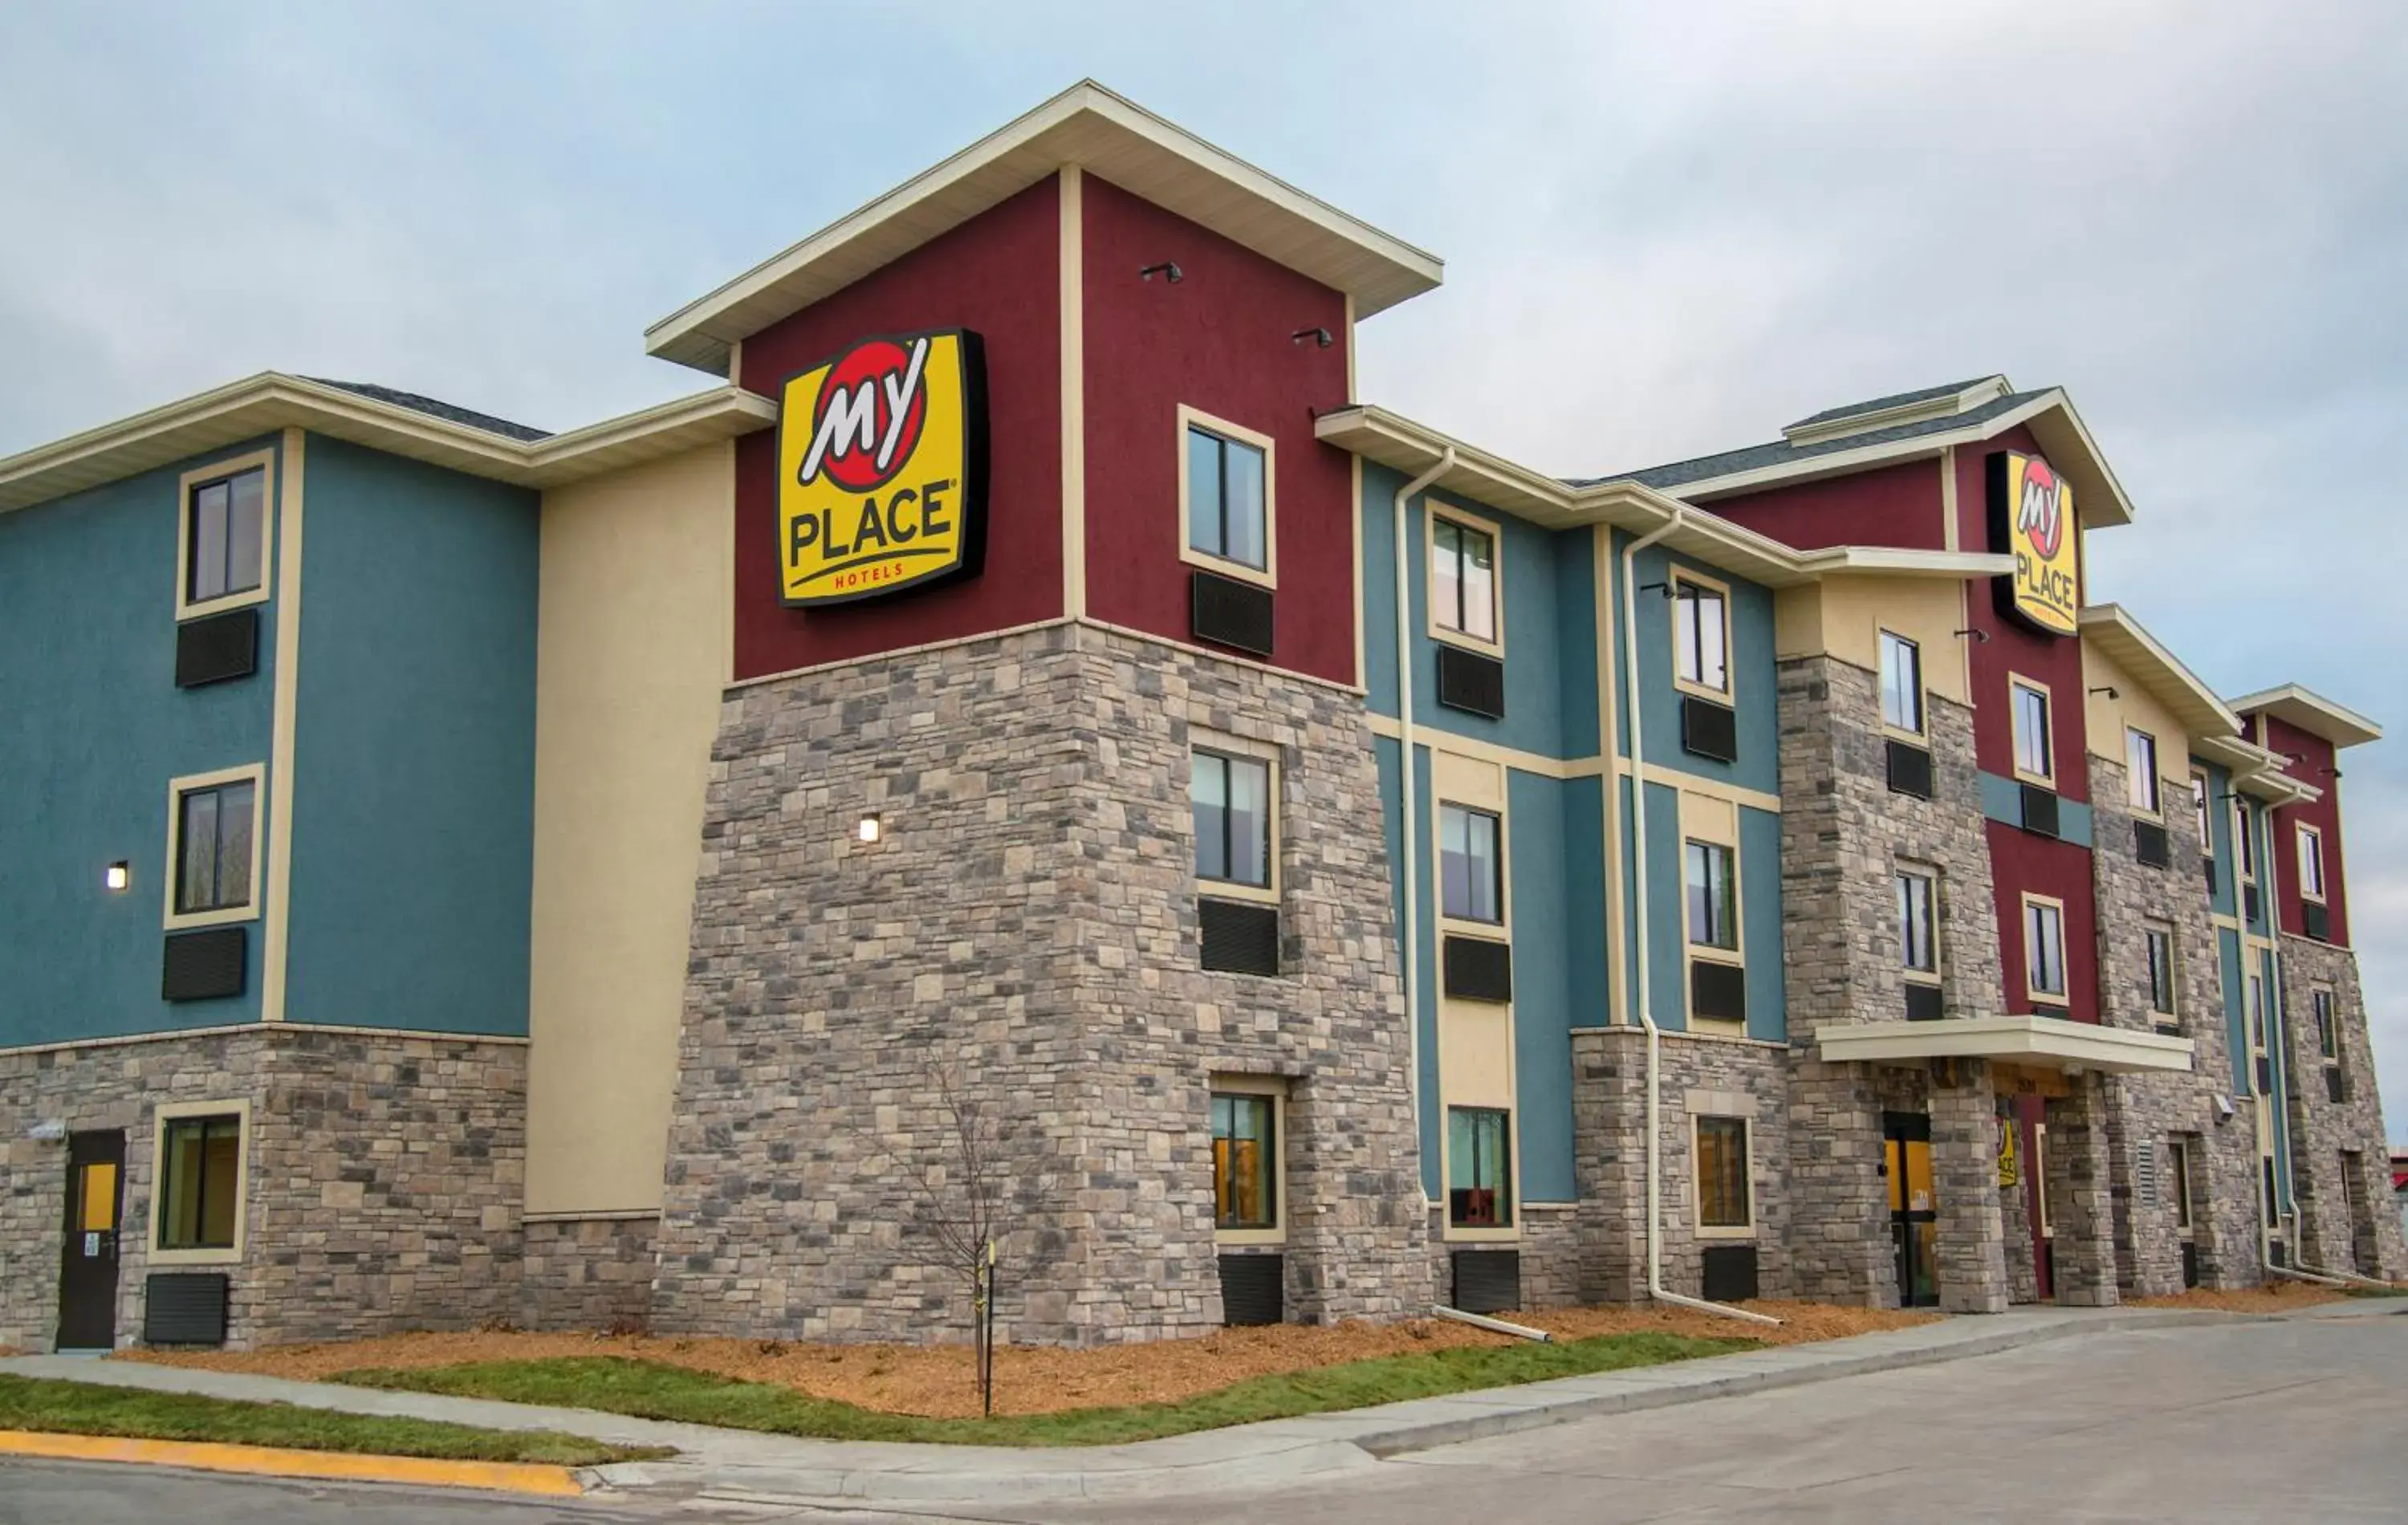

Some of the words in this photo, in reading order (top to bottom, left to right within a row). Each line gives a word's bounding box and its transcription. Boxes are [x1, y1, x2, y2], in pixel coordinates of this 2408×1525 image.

[790, 478, 951, 567] PLACE
[835, 563, 904, 589] HOTELS
[2016, 551, 2073, 610] PLACE
